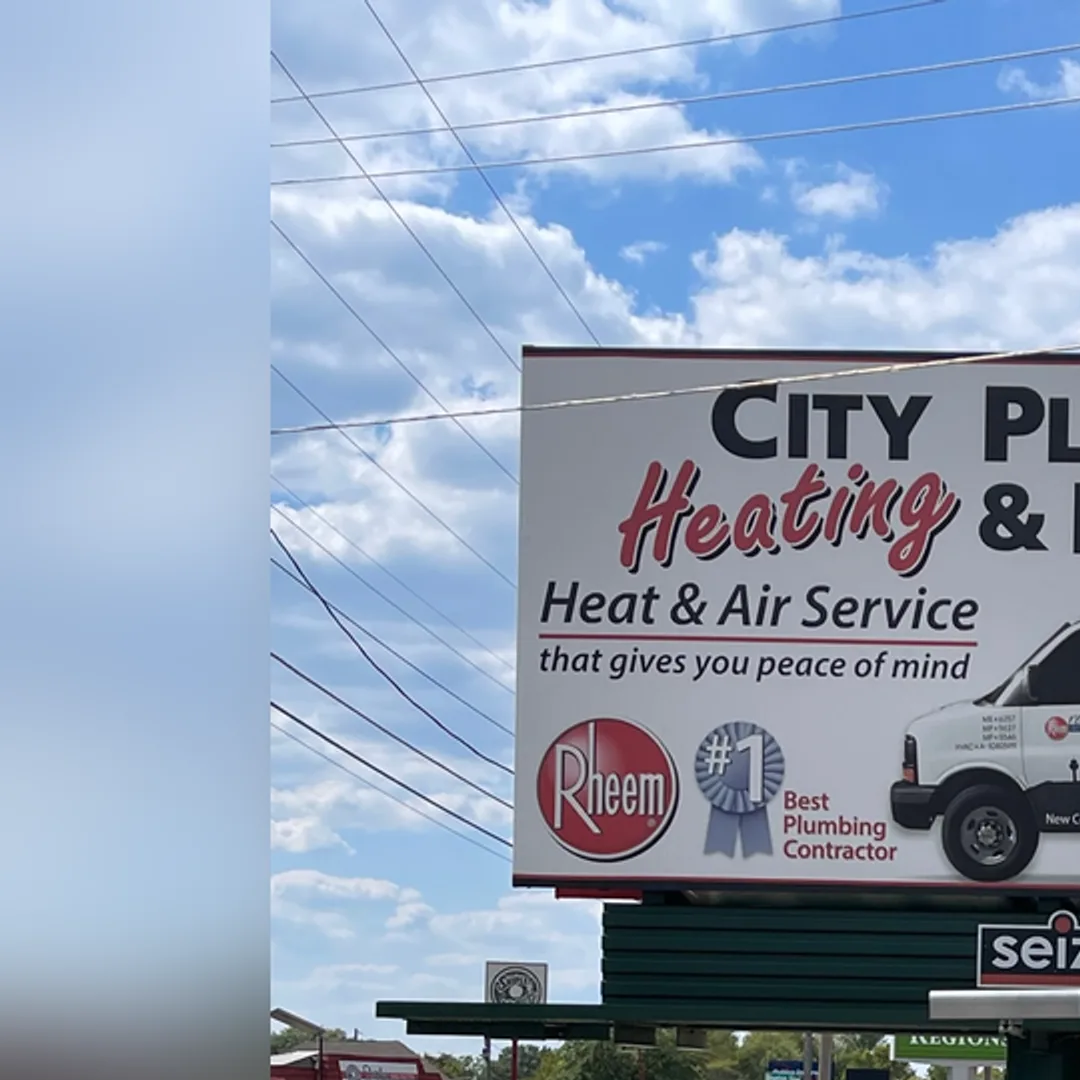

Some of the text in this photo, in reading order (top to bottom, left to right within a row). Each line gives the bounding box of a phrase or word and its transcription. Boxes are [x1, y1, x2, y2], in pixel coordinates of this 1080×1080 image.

[711, 380, 933, 461] CITY
[618, 459, 961, 578] Heating
[978, 484, 1049, 552] &
[539, 581, 979, 631] Heat & Air Service
[539, 646, 970, 682] that gives you peace of mind
[553, 721, 665, 834] Rheem
[704, 733, 765, 804] #1
[783, 790, 829, 810] Best
[1046, 813, 1071, 825] New
[783, 816, 887, 842] Plumbing
[783, 839, 898, 862] Contractor
